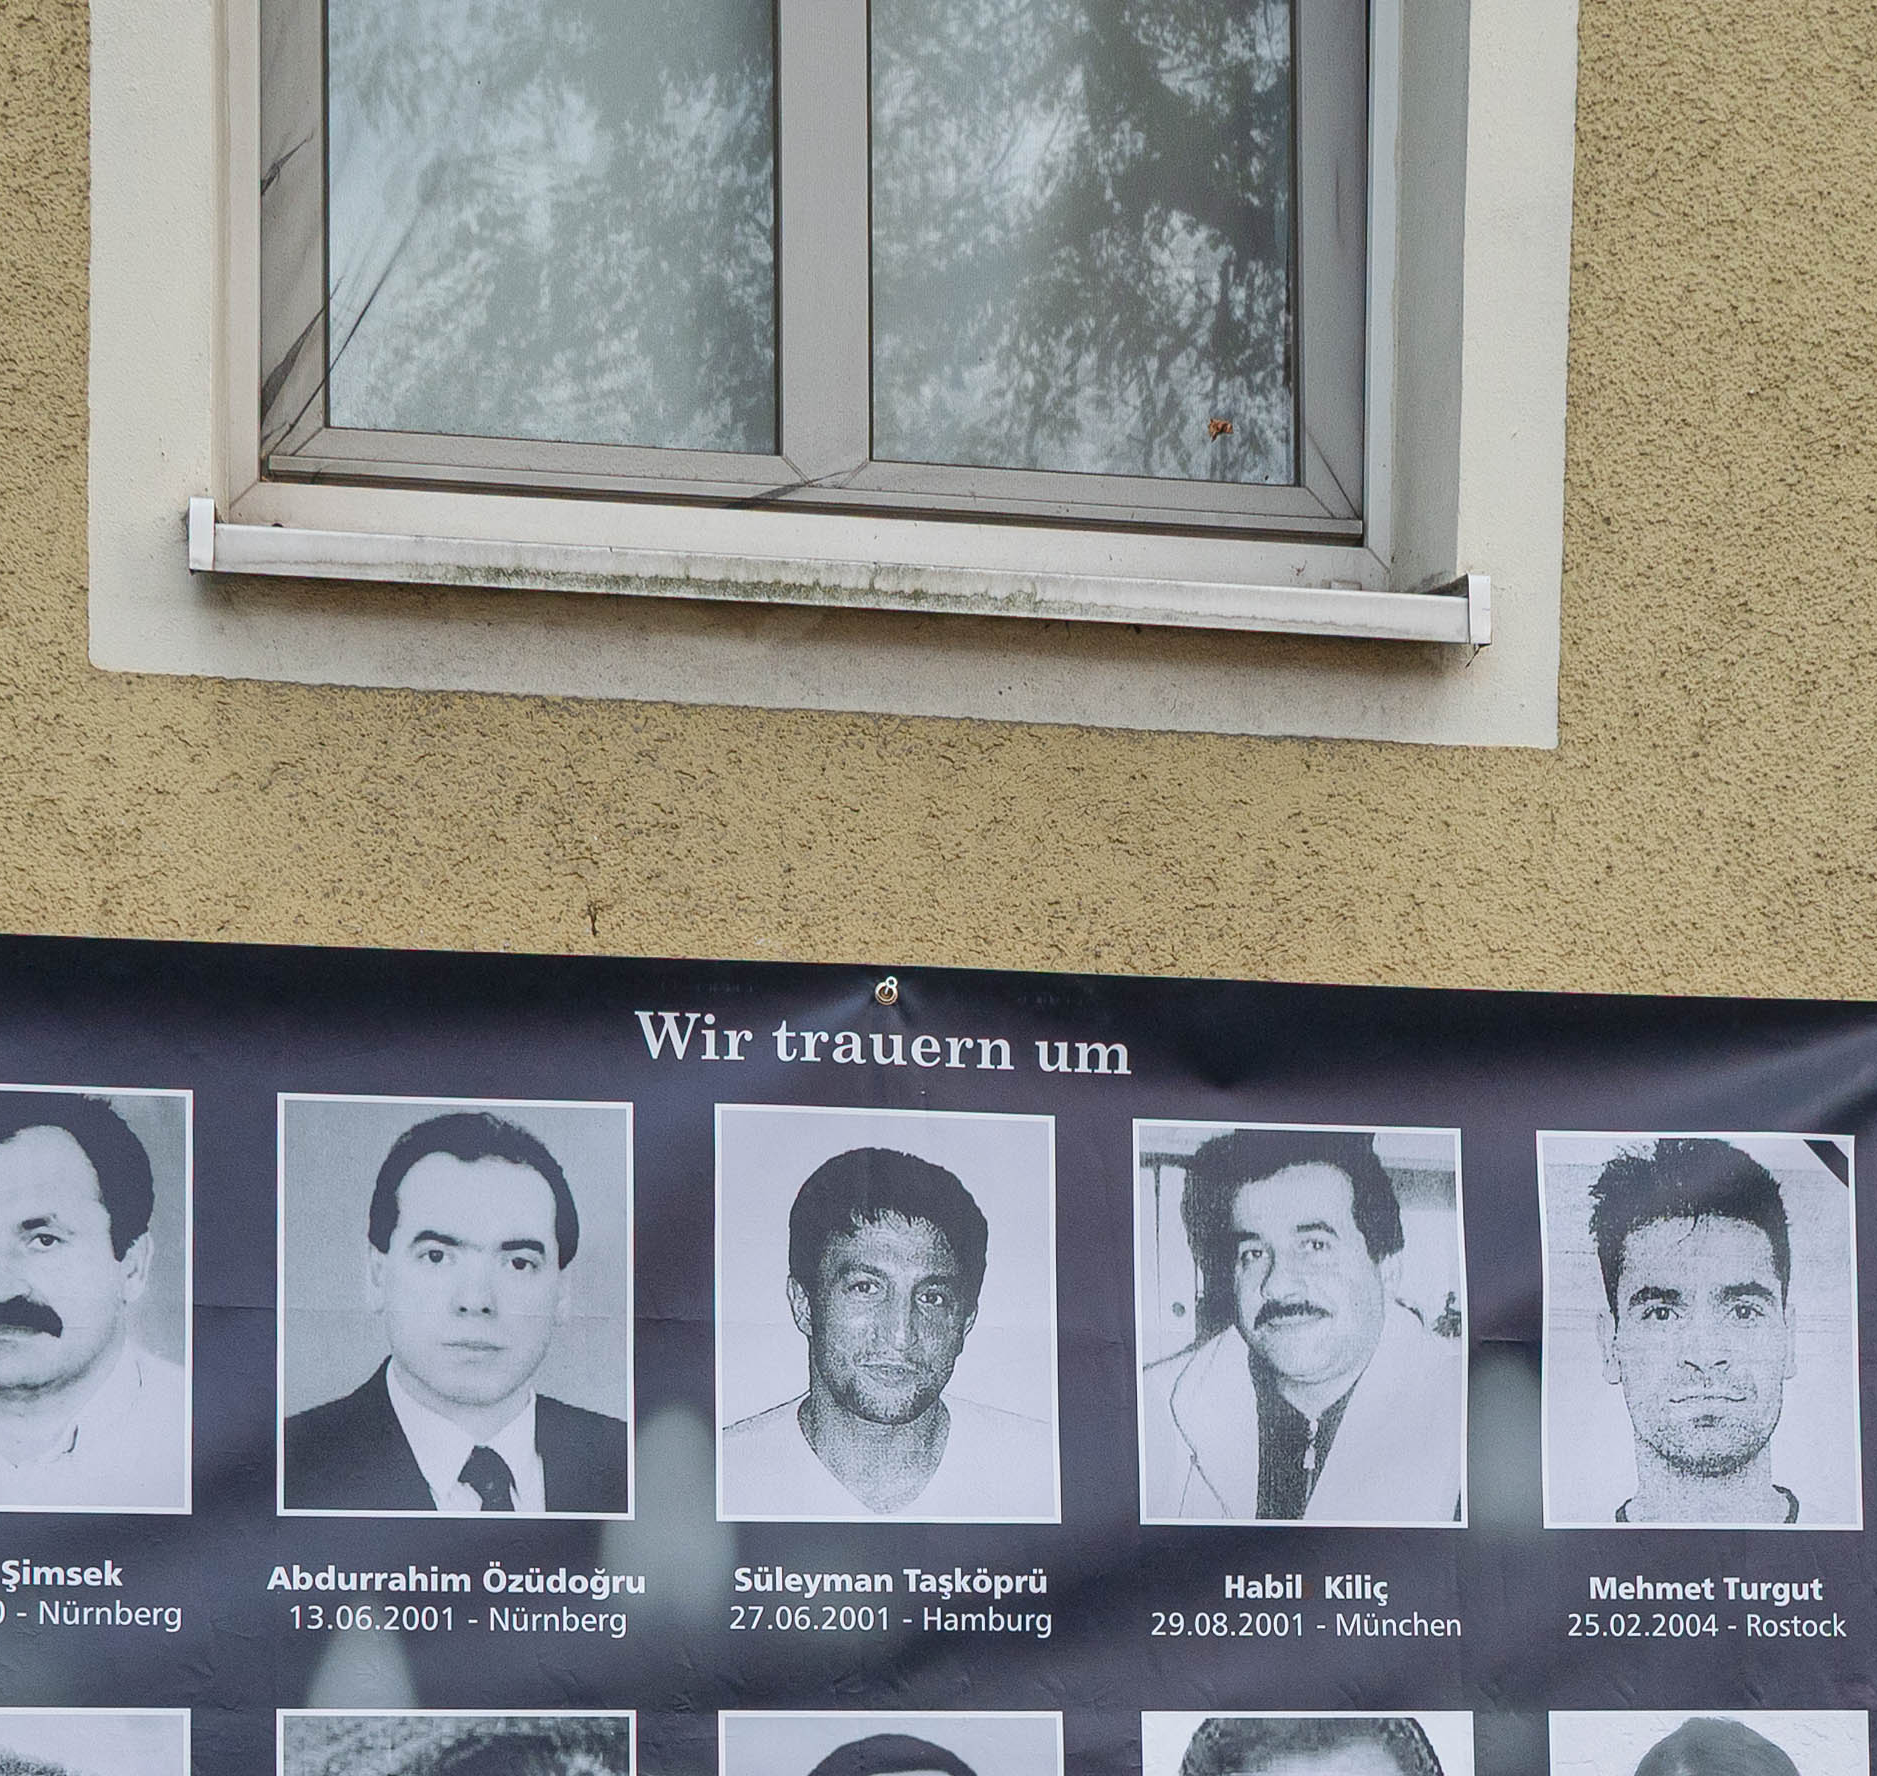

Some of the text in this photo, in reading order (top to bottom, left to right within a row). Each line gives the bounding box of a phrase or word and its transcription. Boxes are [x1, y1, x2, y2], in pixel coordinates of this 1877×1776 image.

[635, 1011, 1131, 1074] Wir trauern um
[2, 1559, 122, 1592] Şimsek
[267, 1559, 646, 1600] Abdurrahim Özüdoğru
[735, 1567, 1046, 1599] Süleyman Taşköprü
[1226, 1574, 1388, 1606] Habil Kiliç
[1590, 1576, 1822, 1606] Mehmet Turgut
[40, 1600, 181, 1632] Nürnberg
[291, 1606, 626, 1638] 13.06.2001 Nürnberg
[730, 1606, 1051, 1638] 27.06.2001 Hamburg
[1152, 1612, 1461, 1636] 29.08.2001 München
[1569, 1613, 1846, 1637] 25.02.2004 Rostock
